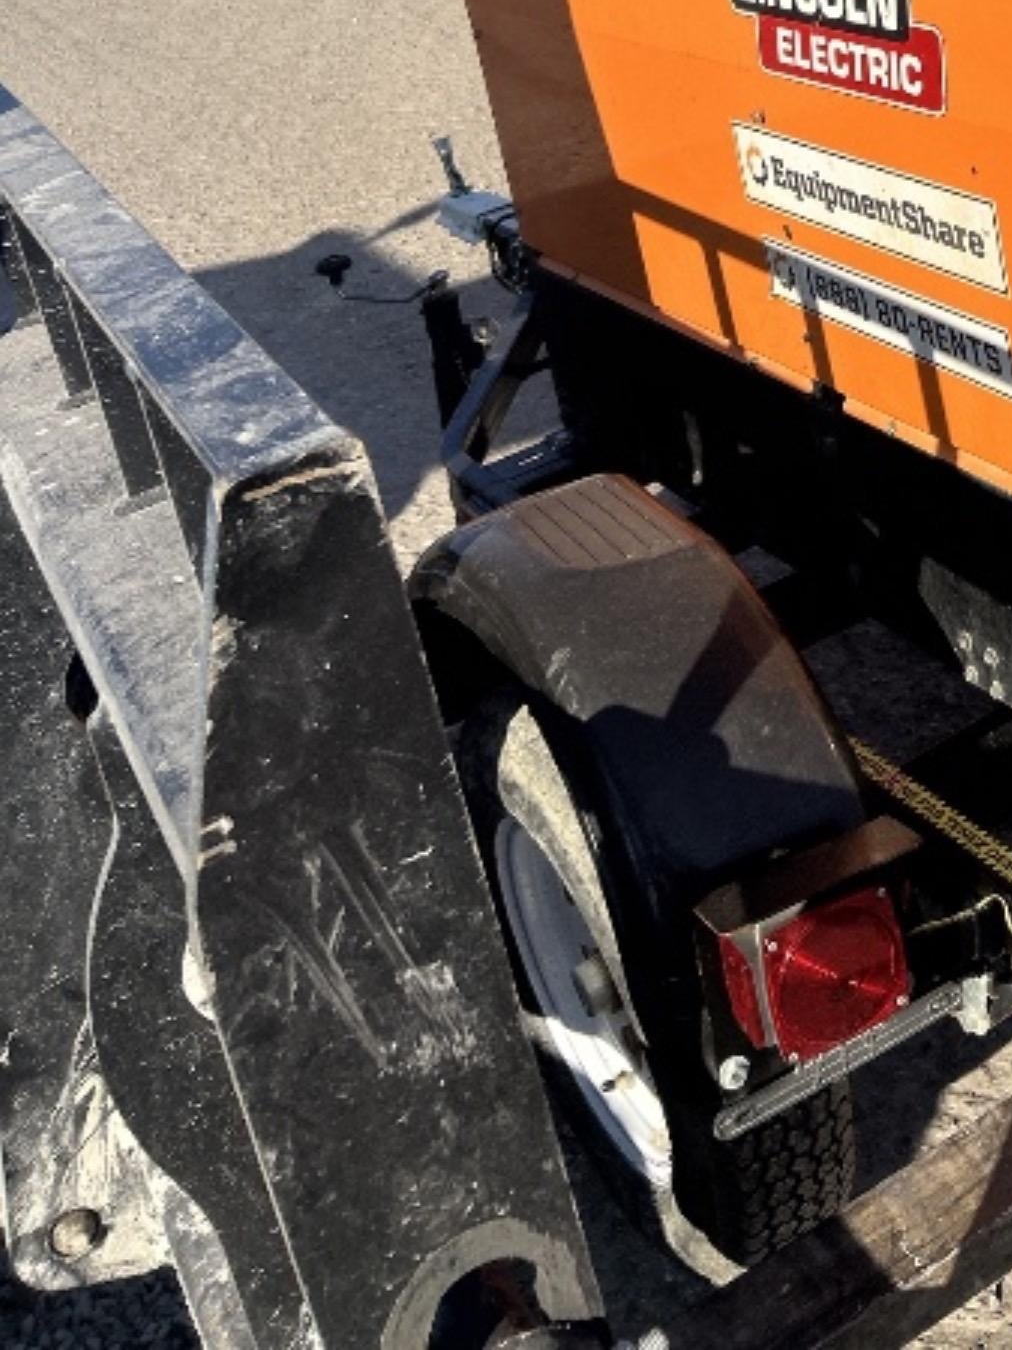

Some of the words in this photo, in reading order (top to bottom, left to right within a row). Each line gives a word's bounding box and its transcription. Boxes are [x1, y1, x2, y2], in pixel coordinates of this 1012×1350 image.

[774, 27, 925, 97] ELECTRIC
[770, 157, 986, 259] EquipmentShare
[806, 266, 871, 321] (888)
[875, 298, 1003, 376] 80-RENTS
